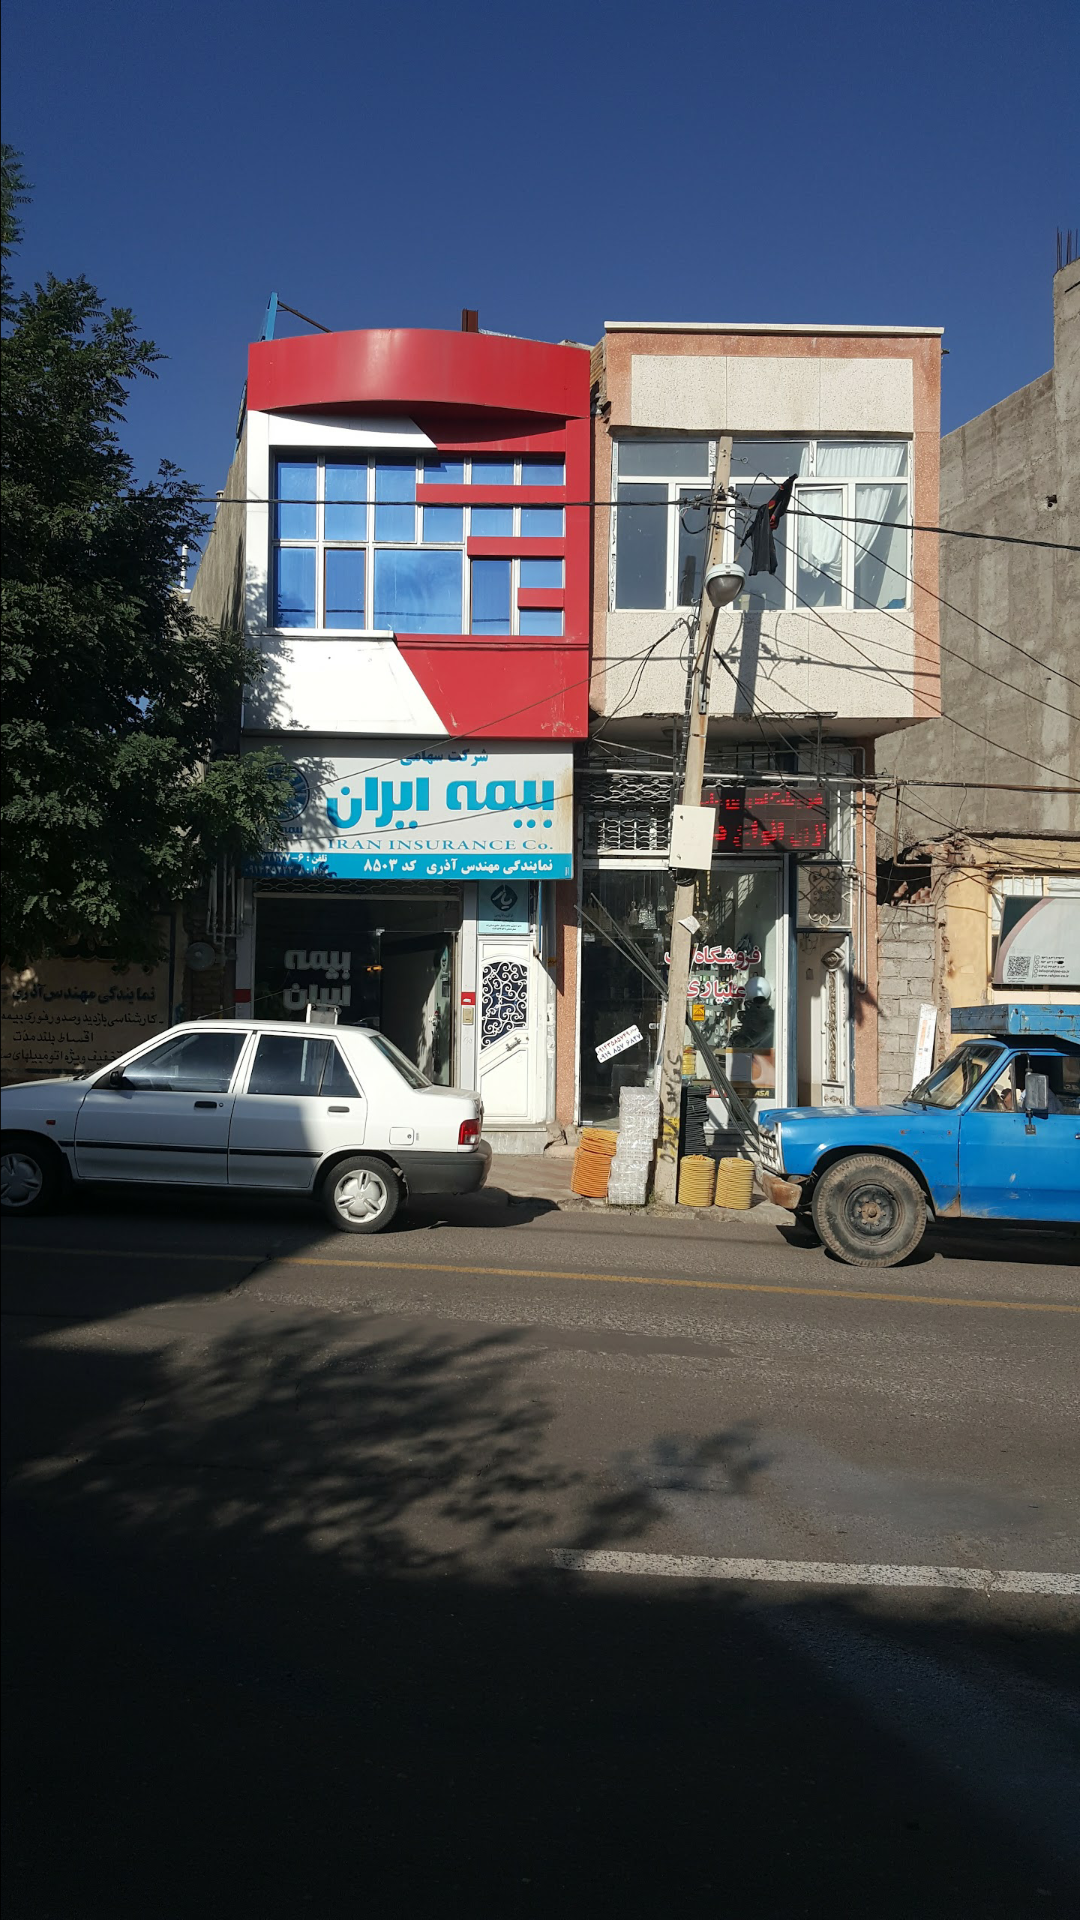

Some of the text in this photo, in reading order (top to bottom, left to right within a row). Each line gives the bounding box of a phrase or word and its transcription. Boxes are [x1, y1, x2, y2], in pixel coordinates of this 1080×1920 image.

[400, 748, 488, 767] شرکت سهامی
[327, 777, 555, 829] بیمه ایران
[328, 839, 553, 851] IRAN INSURANCE Co.
[363, 858, 399, 872] ۸۵۰۳
[401, 860, 417, 873] کد
[426, 858, 458, 876] آذری
[460, 860, 502, 876] مهندس
[503, 858, 553, 876] نمایندگی
[283, 949, 352, 980] بیمه
[694, 945, 761, 970] فروشگاه
[12, 983, 46, 1001] آذری
[43, 986, 96, 1003] مهندس
[98, 985, 156, 1004] نمایندگی
[1, 1013, 23, 1024] بیمه
[25, 1010, 50, 1025] فوری
[82, 1013, 108, 1027] بازدید
[108, 1011, 158, 1026] کارشناسی
[58, 1030, 94, 1043] اقساط
[64, 1048, 86, 1064] ویژه
